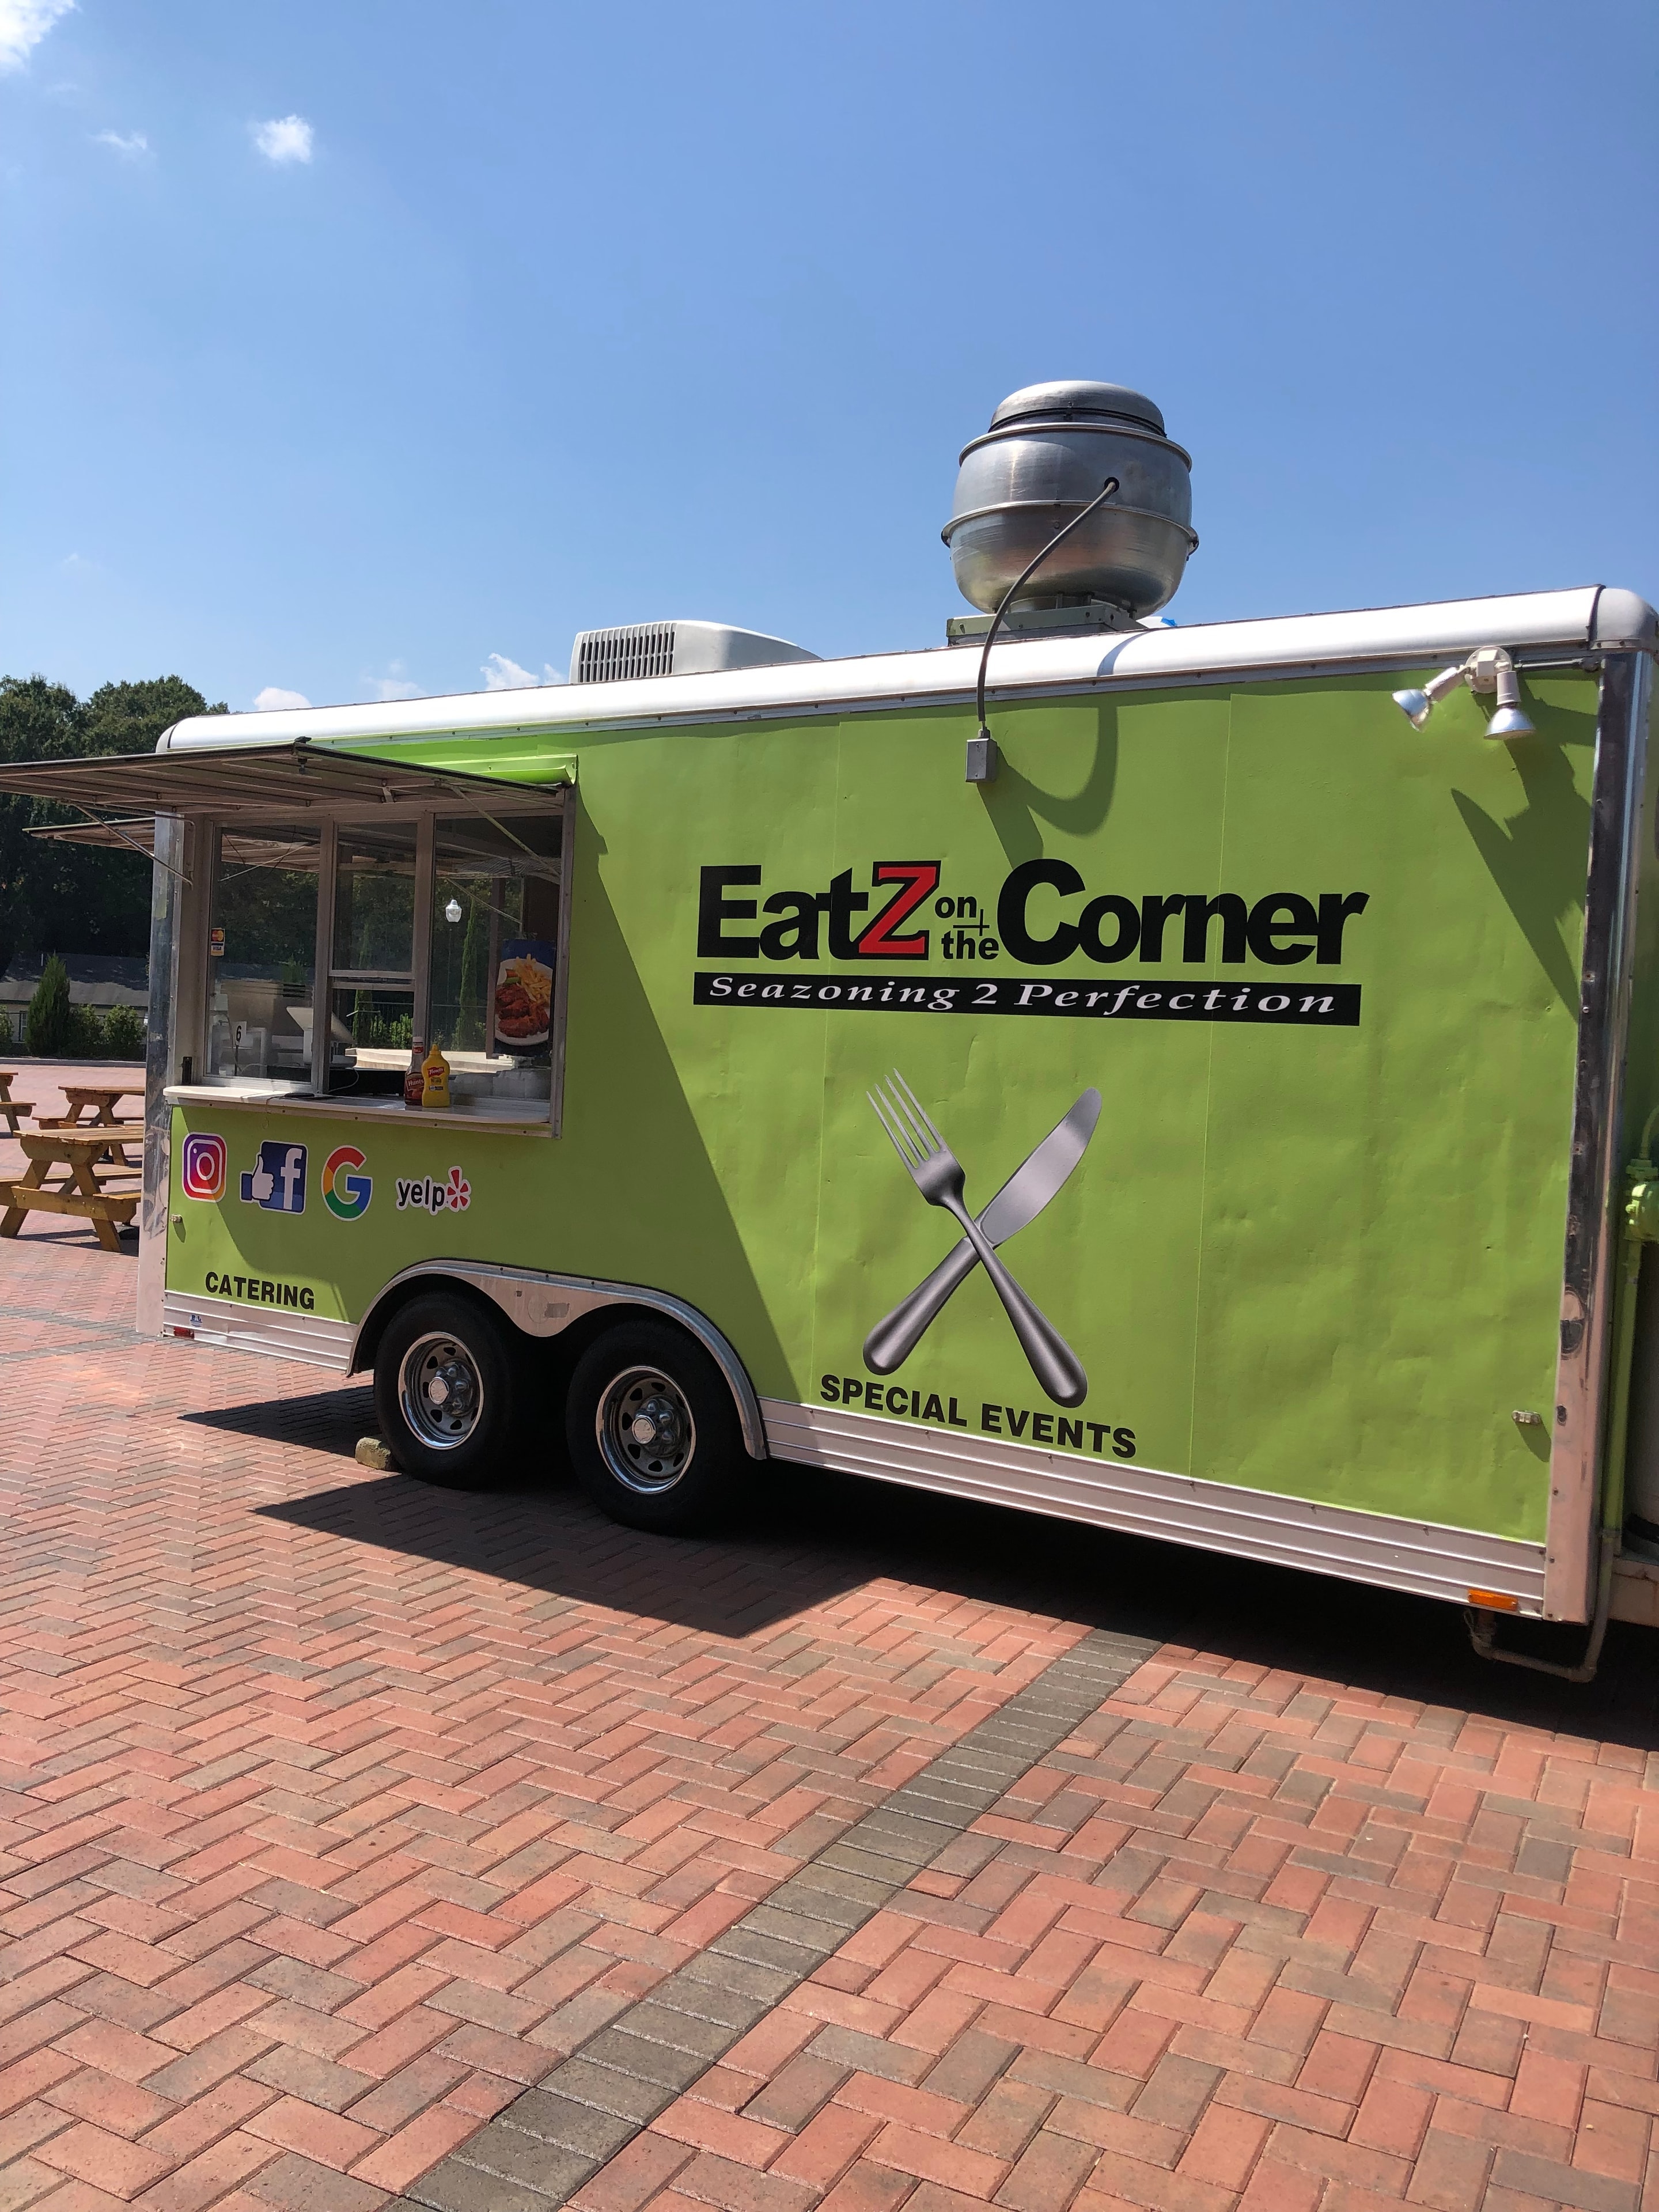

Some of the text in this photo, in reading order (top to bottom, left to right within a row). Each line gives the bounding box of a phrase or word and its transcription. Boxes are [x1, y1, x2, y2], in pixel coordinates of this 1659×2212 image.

[697, 858, 1370, 965] EatZ on the Corner
[709, 977, 1335, 1016] Seazoning 2 Perfection
[236, 1025, 241, 1042] 6
[323, 1146, 372, 1219] G
[399, 1179, 445, 1211] yelp
[206, 1272, 315, 1310] CATERING
[820, 1374, 1136, 1458] SPECIAL EVENTS
